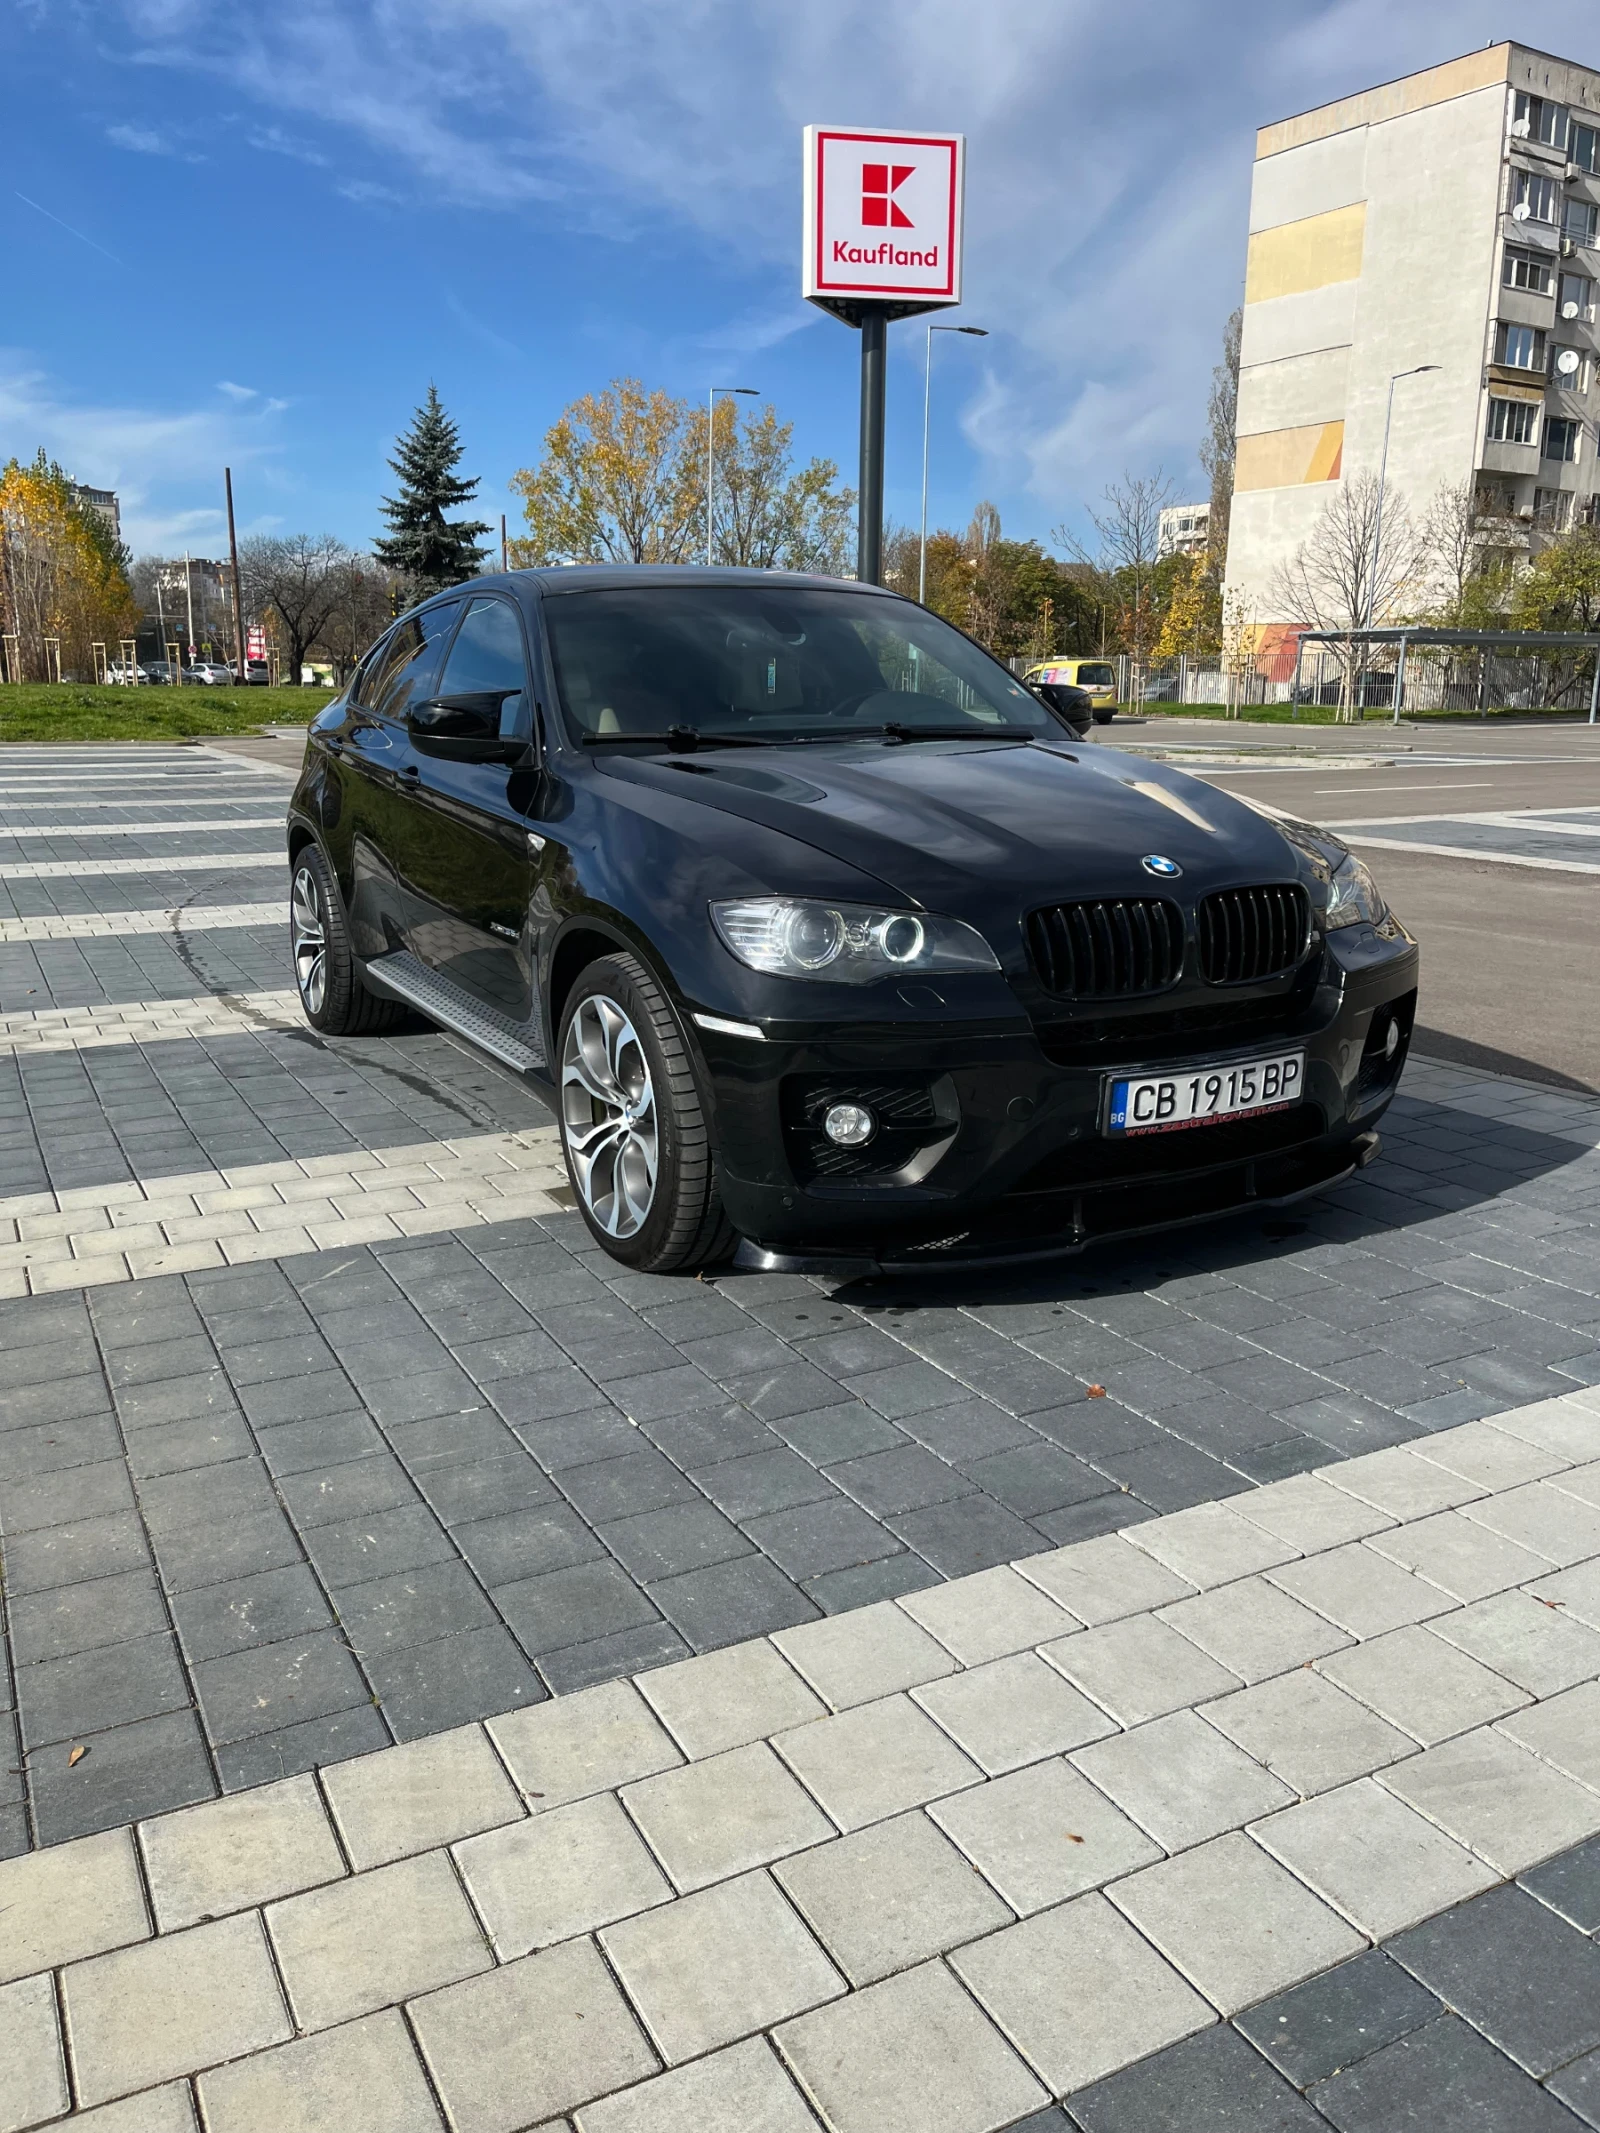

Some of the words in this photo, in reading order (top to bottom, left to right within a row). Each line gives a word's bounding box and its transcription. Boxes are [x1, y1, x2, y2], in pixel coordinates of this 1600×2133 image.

[862, 163, 917, 228] K
[833, 240, 938, 267] Kaufland
[1132, 1082, 1176, 1122] CB
[1189, 1067, 1256, 1114] 1915
[1262, 1059, 1299, 1100] BP
[1110, 1112, 1125, 1124] BG
[1125, 1102, 1290, 1138] www.zastrahovam.com
